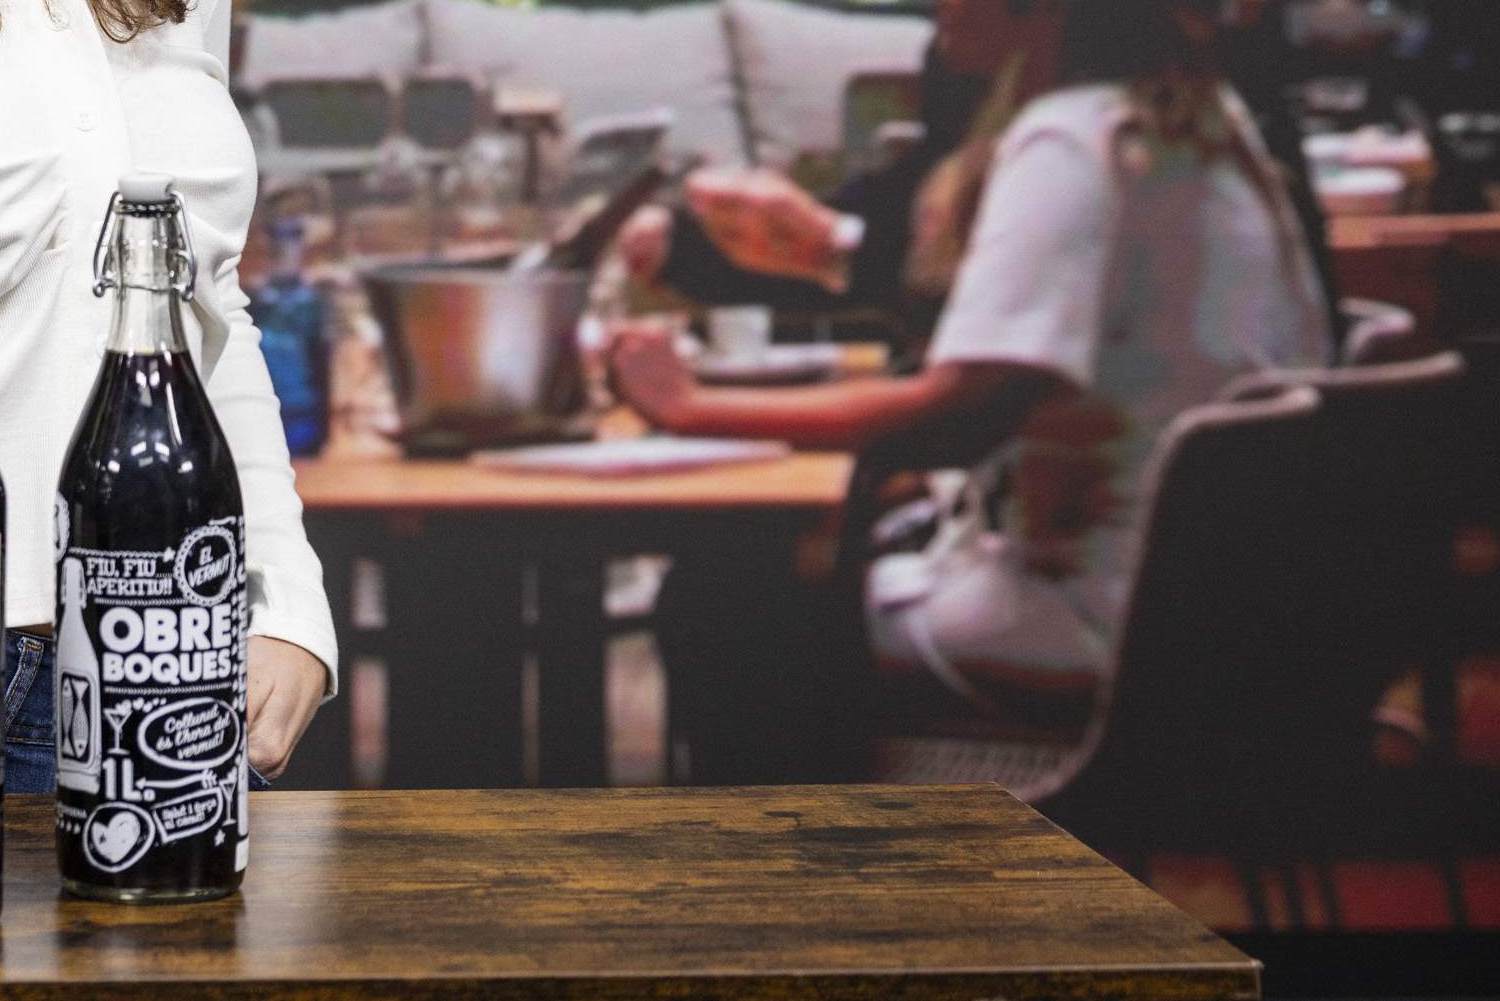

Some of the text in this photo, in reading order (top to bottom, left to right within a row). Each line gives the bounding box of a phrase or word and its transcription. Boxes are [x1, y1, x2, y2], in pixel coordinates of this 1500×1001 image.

[86, 558, 156, 577] FIU, FIU
[199, 545, 214, 566] EL
[188, 553, 231, 587] VERMUT
[100, 603, 232, 653] OBRE
[102, 648, 232, 685] BOQUES
[213, 711, 231, 733] del
